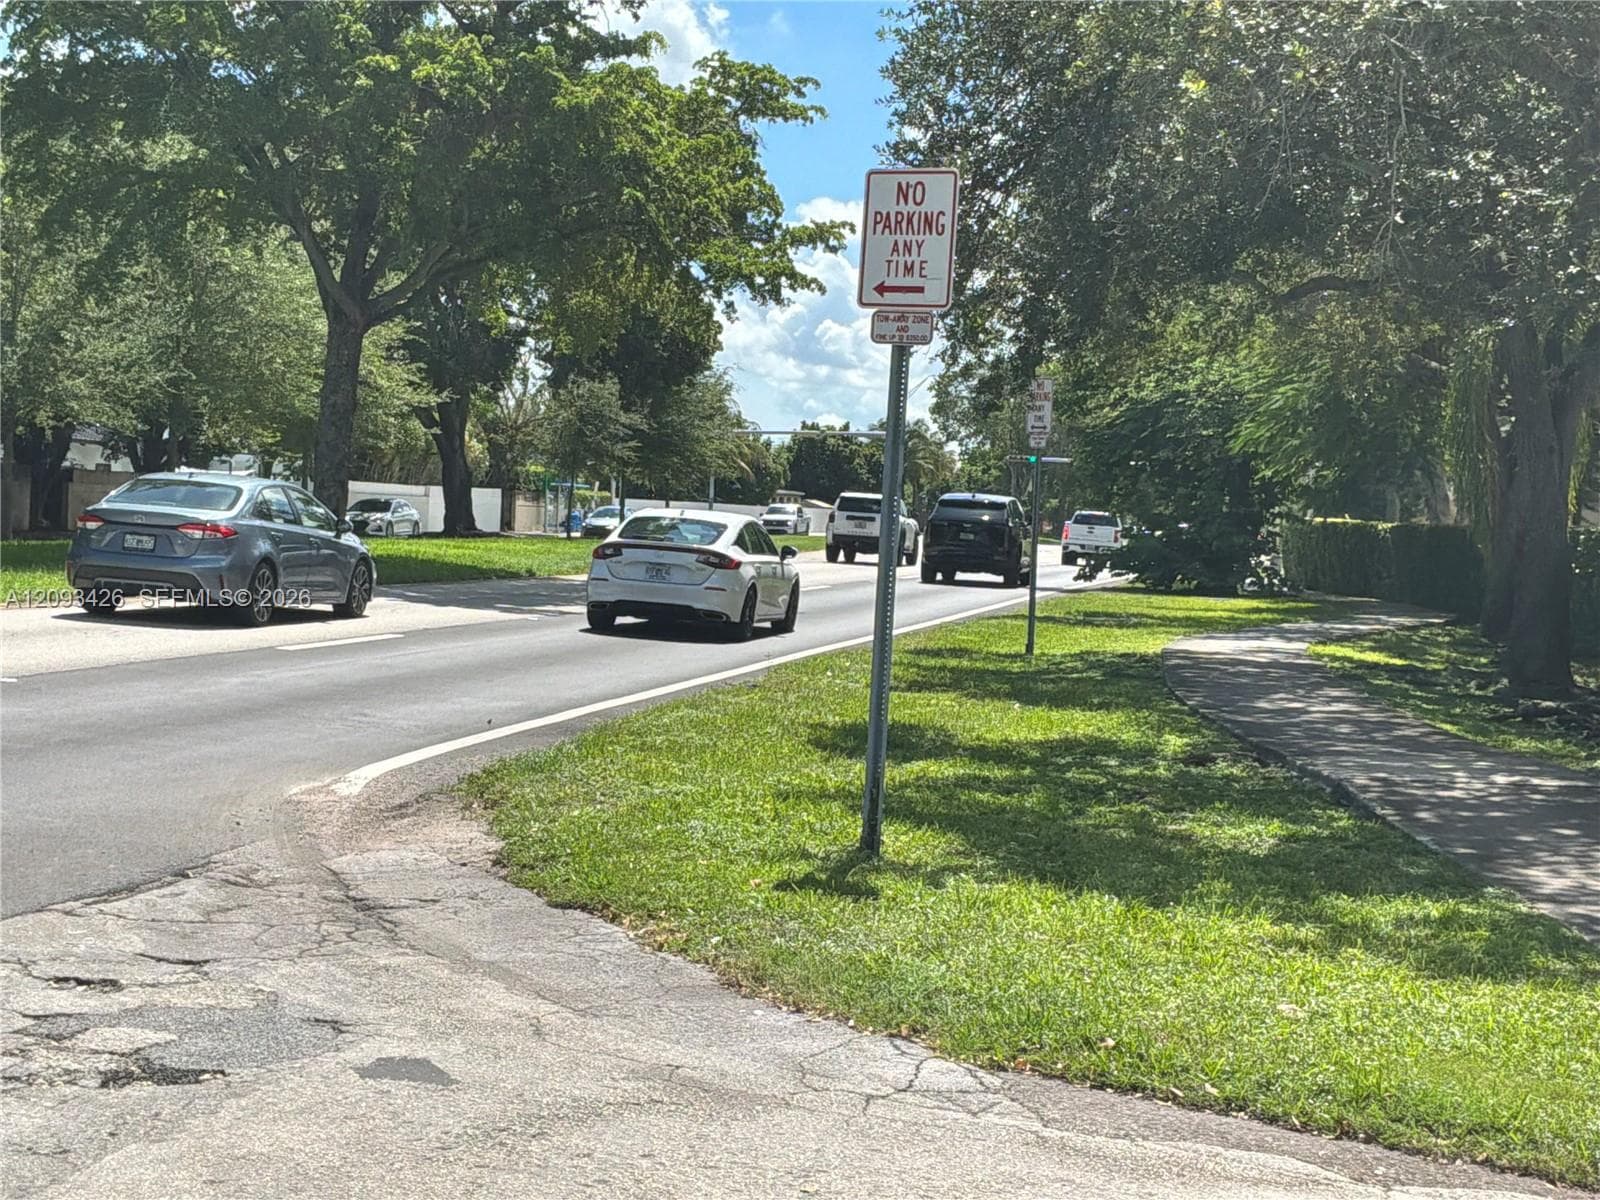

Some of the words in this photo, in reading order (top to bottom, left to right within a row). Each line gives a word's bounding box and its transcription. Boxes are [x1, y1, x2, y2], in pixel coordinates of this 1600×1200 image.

[896, 181, 926, 206] NO
[873, 211, 945, 236] PARKING
[890, 239, 926, 257] ANY
[885, 259, 928, 278] TIME
[912, 315, 931, 324] ZONE
[895, 325, 910, 333] AND
